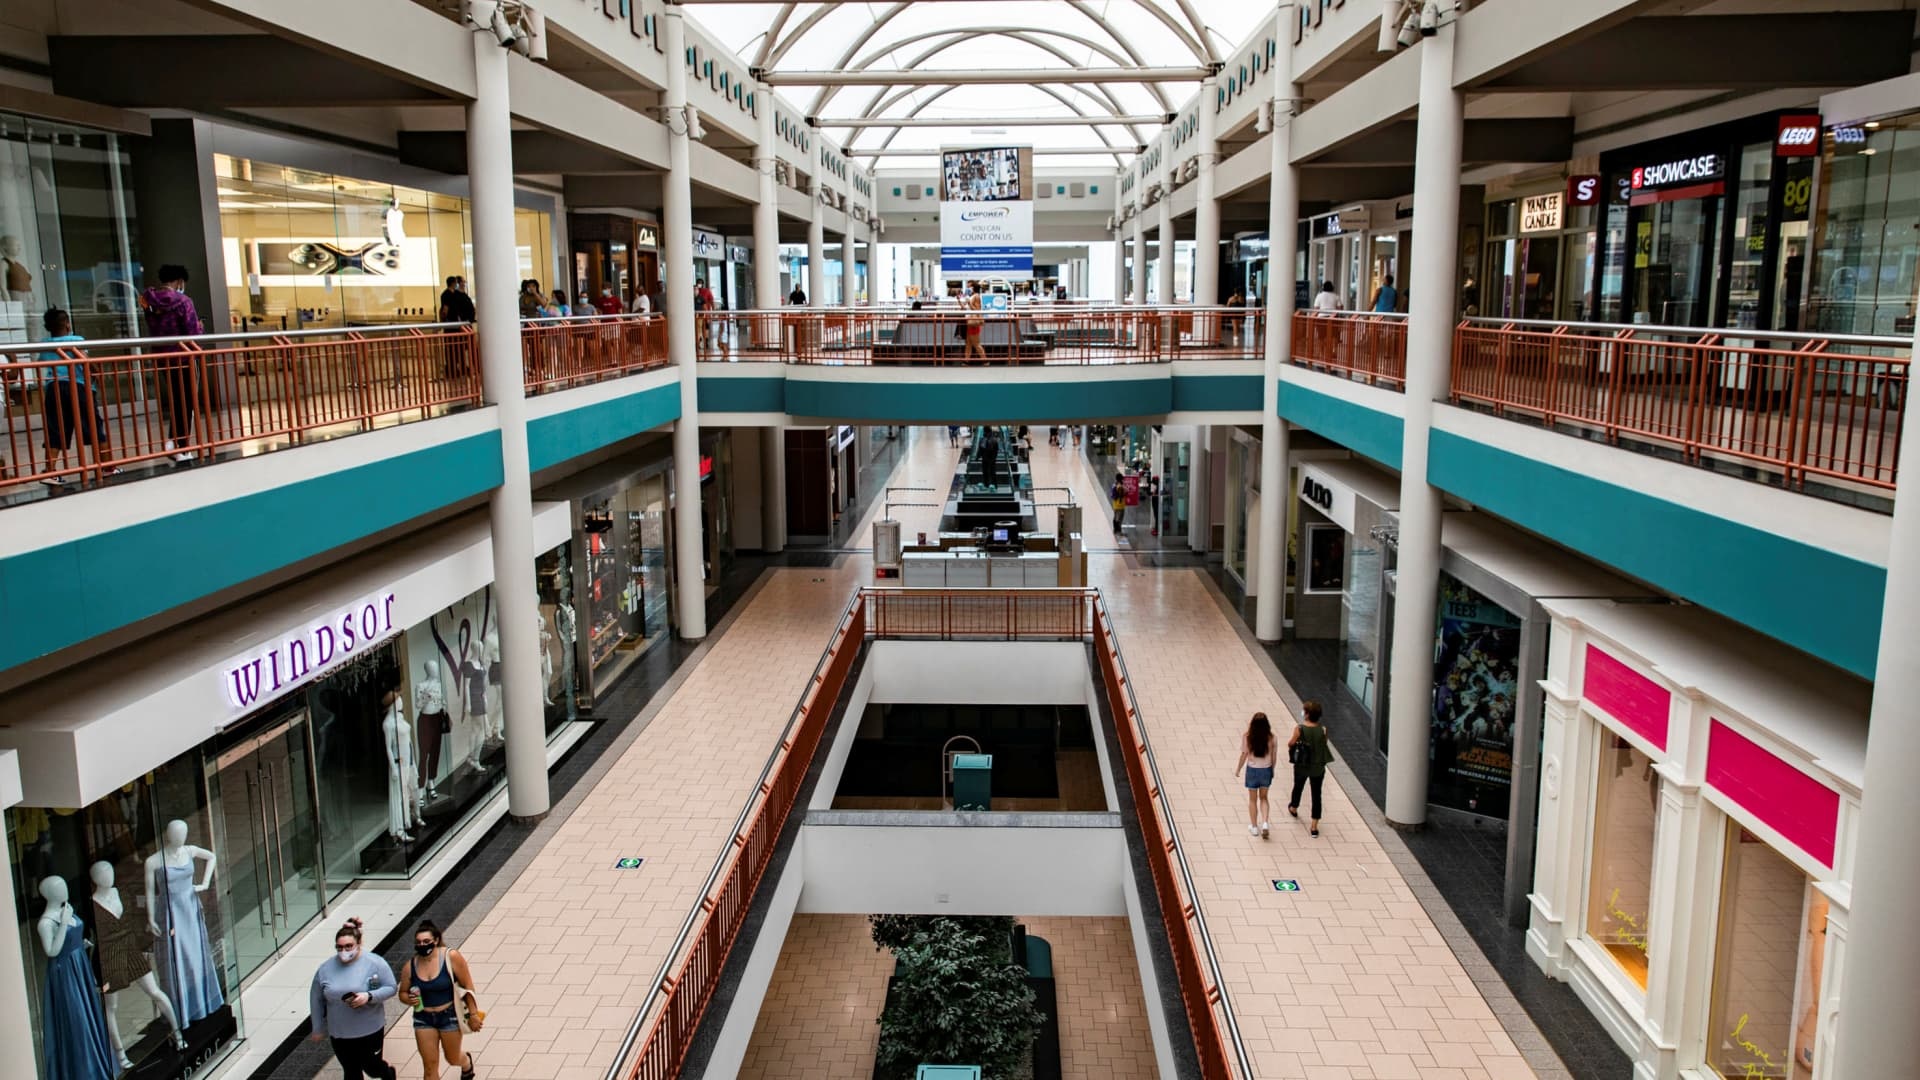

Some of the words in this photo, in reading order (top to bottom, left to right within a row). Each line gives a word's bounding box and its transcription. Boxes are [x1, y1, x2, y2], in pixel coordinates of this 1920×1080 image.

[1779, 127, 1817, 145] LEGO
[1644, 154, 1716, 186] SHOWCASE
[1526, 195, 1558, 212] YANKEE
[1524, 212, 1557, 230] CANDLE
[960, 233, 987, 241] COUNT
[988, 233, 1001, 241] ON
[1002, 233, 1013, 241] US
[1302, 476, 1333, 509] ALDO
